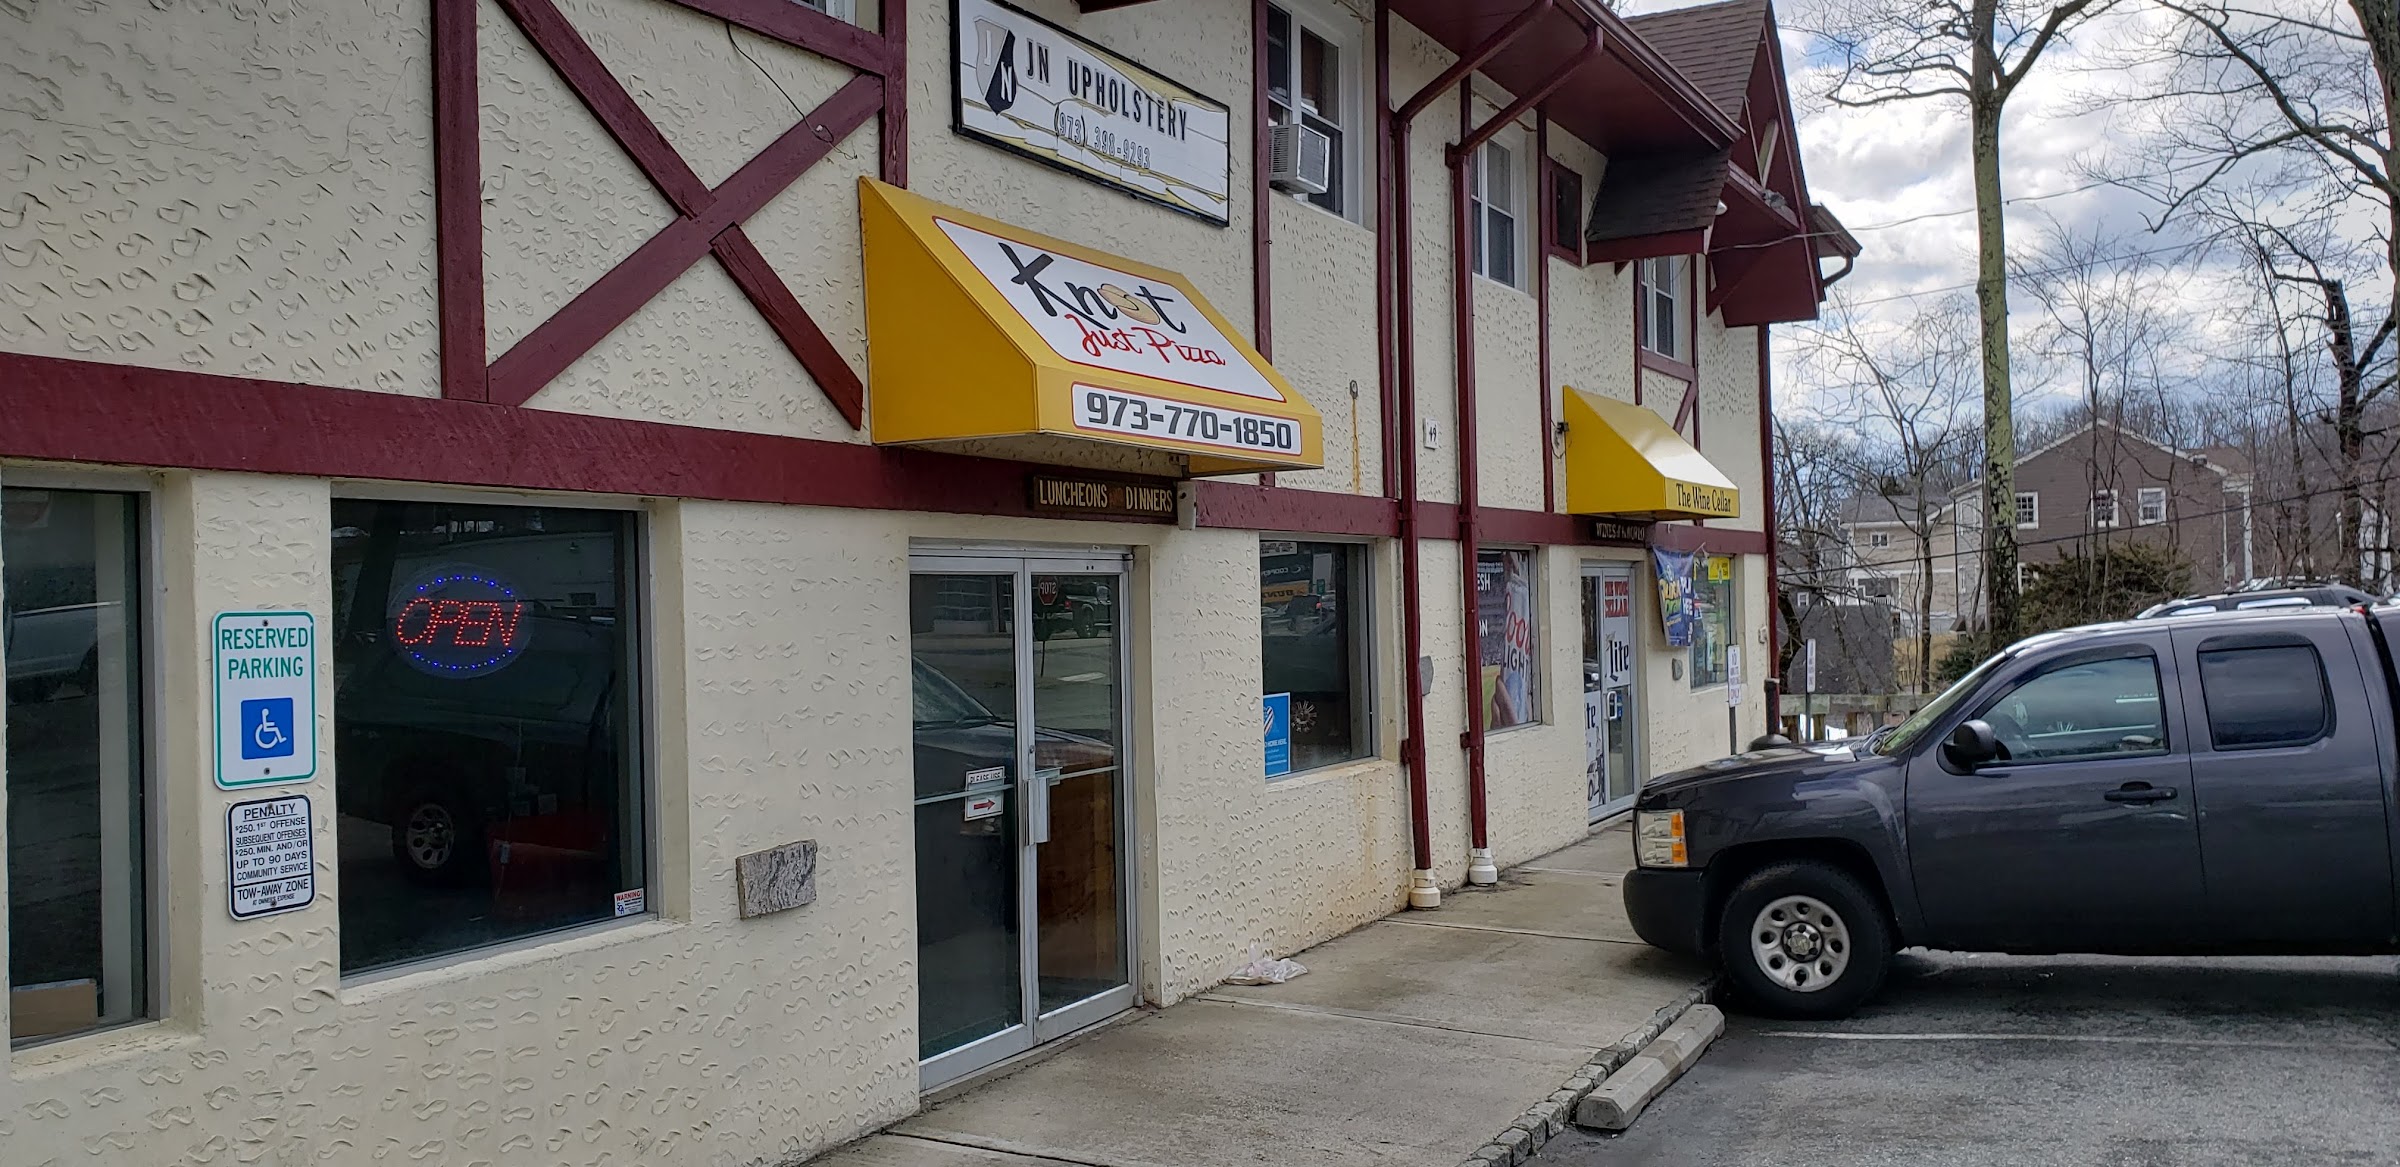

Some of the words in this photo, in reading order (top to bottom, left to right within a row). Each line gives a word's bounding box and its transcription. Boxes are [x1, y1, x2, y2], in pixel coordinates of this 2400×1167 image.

[1025, 38, 1050, 84] JN
[1067, 58, 1187, 142] UPHOLSTERY
[1054, 105, 1086, 147] (973)
[1094, 127, 1151, 169] 398-9293
[998, 242, 1187, 334] Knot
[1065, 314, 1142, 357] Just
[1131, 326, 1226, 366] Pizza
[1086, 391, 1292, 450] 973-770-1850
[1039, 479, 1108, 508] LUNCHEONS
[1126, 486, 1173, 512] DINNERS
[1676, 483, 1691, 508] The
[1692, 486, 1710, 510] Wine
[1712, 489, 1731, 512] Cellar
[396, 597, 523, 647] OPEN
[221, 627, 309, 651] RESERVED
[228, 656, 304, 680] PARKING
[1605, 640, 1629, 682] Lite
[1586, 703, 1596, 729] te
[244, 803, 296, 820] PENALTY
[269, 817, 306, 829] OFFENSE
[235, 833, 275, 846] SUBSEQUENT
[276, 828, 307, 840] OFFENSES
[256, 845, 274, 854] MIN.
[276, 840, 308, 851] AND/OR
[236, 860, 249, 869] UP
[252, 857, 265, 866] TO
[269, 854, 281, 864] 90
[285, 851, 308, 862] DAYS
[237, 867, 278, 881] COMMUNITY
[280, 862, 308, 874] SERVICE
[237, 883, 282, 901] TOW-AWAY
[285, 878, 309, 892] ZONE
